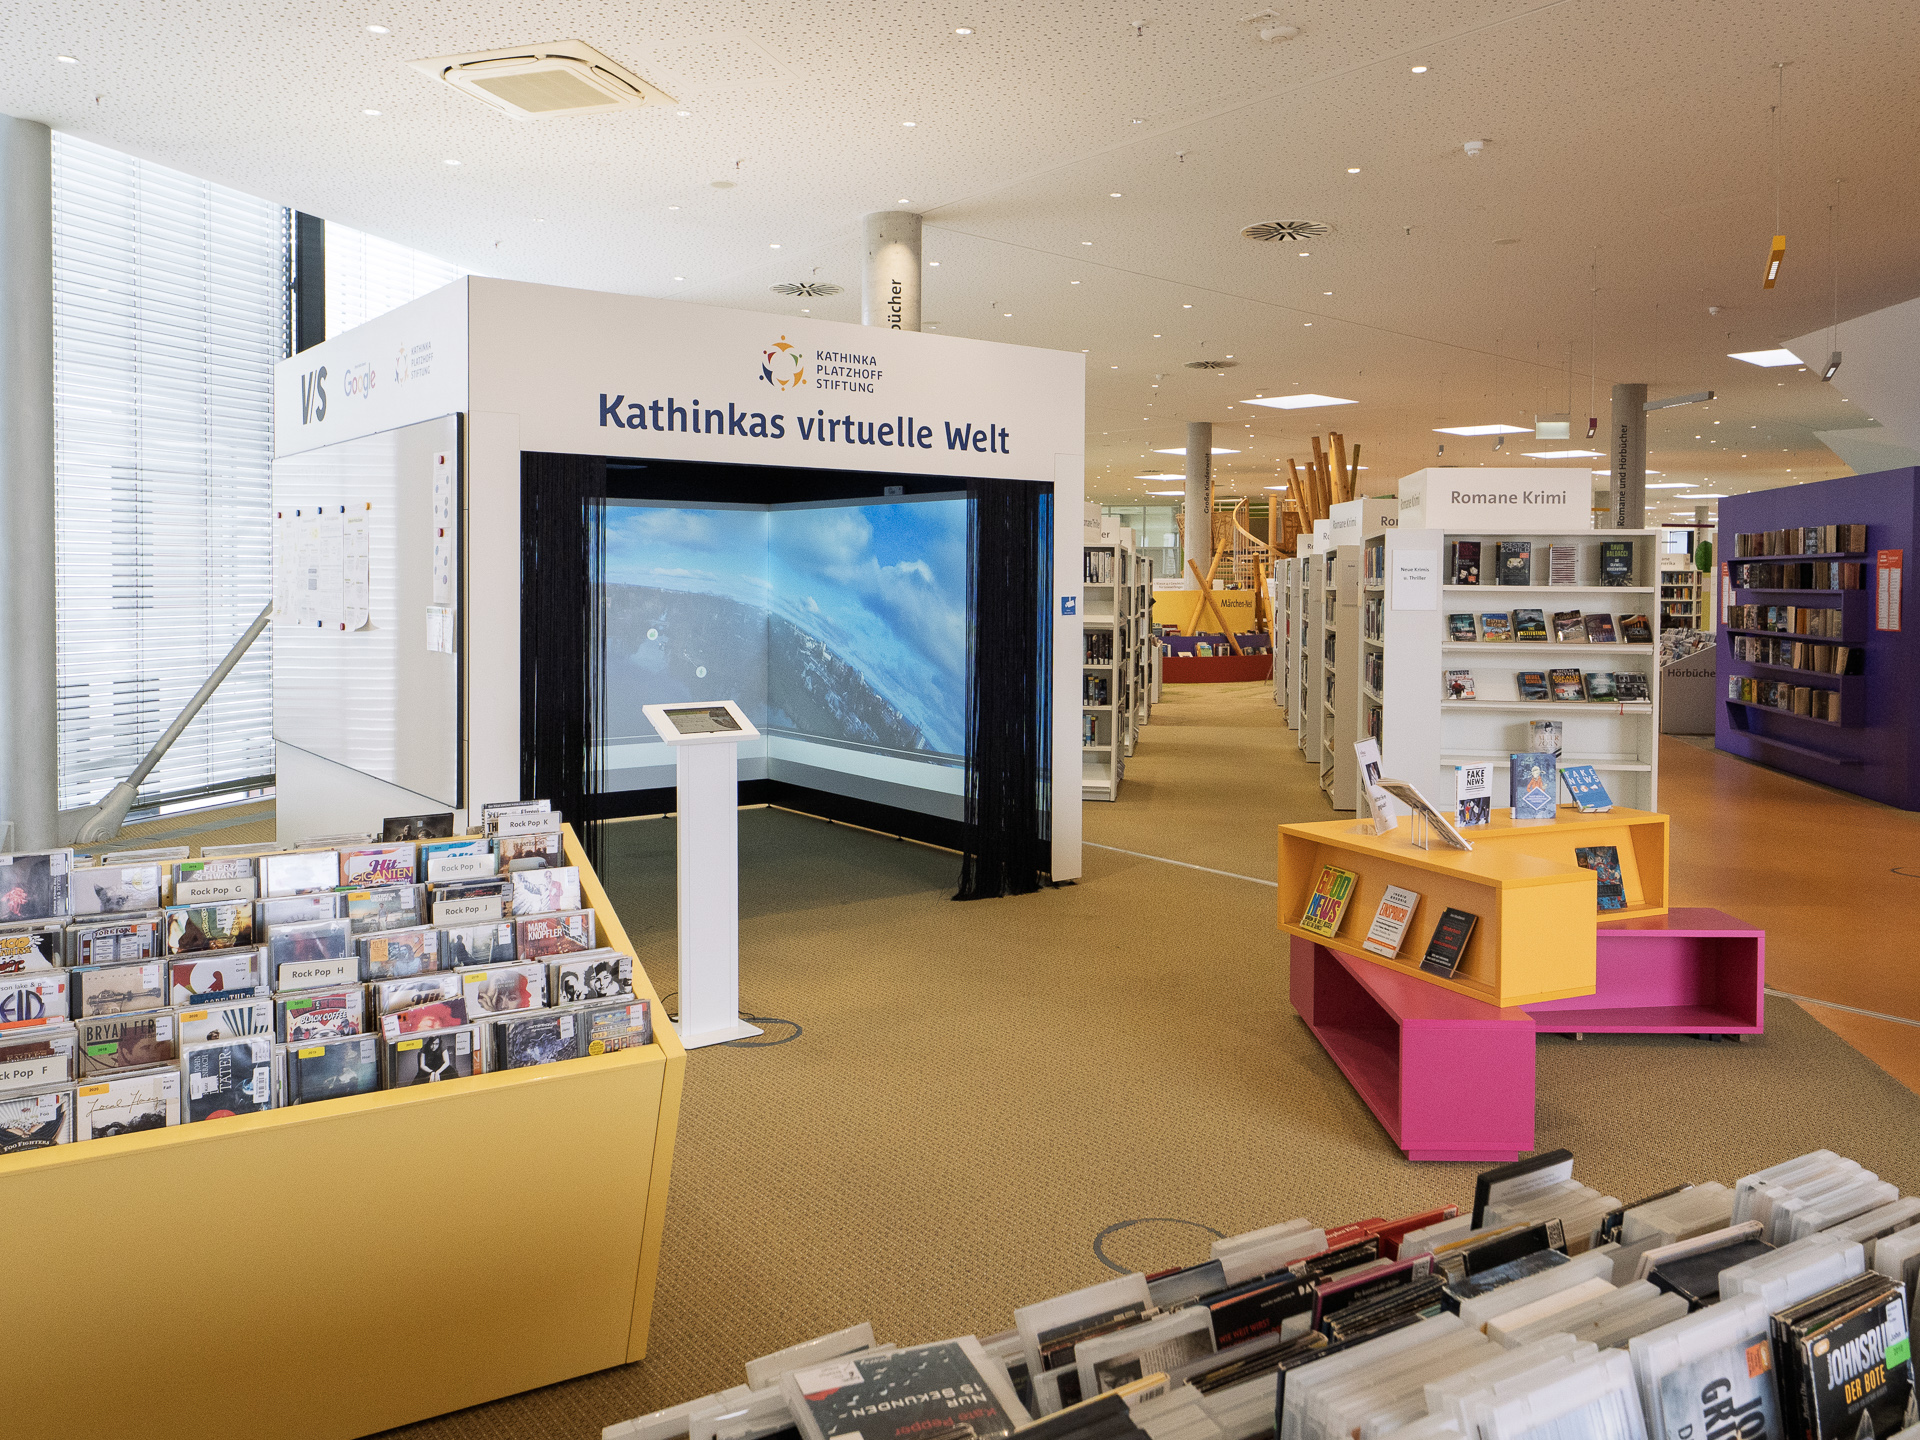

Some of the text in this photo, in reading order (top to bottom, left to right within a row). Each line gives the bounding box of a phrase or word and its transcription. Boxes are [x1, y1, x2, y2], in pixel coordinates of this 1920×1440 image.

[411, 341, 432, 355] KATHINKA
[411, 353, 434, 367] PLATZHOFF
[816, 350, 877, 366] KATHINKA
[411, 366, 431, 380] STIFTUNG
[816, 365, 883, 381] PLATZHOFF
[344, 362, 376, 399] Google
[816, 379, 874, 394] STIFTUNG
[599, 394, 1010, 454] Kathinkas virtuelle Welt
[1619, 425, 1628, 471] Hörbücher
[1451, 491, 1567, 504] Romane Krimi
[1617, 489, 1626, 527] Romane
[1467, 769, 1485, 778] FAKE
[1564, 768, 1595, 778] FAKE
[1569, 775, 1600, 785] NEWS
[1466, 777, 1485, 786] NEWS
[460, 863, 474, 871] Pop
[351, 867, 413, 882] GIGANTEN
[190, 885, 242, 896] Rock Pop G
[1316, 870, 1352, 900] GOOD
[445, 904, 488, 915] Rock Pop J
[1306, 893, 1342, 923] NEWS
[528, 921, 548, 933] MARK
[528, 928, 563, 941] KNOPFLER
[292, 966, 344, 978] Rock Pop H
[300, 1010, 348, 1024] BLACK COFFEE
[86, 1022, 127, 1041] BRYAN
[13, 1068, 34, 1079] Pop
[42, 1066, 48, 1075] F
[1844, 1379, 1863, 1404] DER
[1865, 1364, 1886, 1393] BOTE
[852, 1387, 957, 1419] SEKUNDEN
[946, 1392, 988, 1409] NUR
[894, 1407, 997, 1437] Kate Pepper
